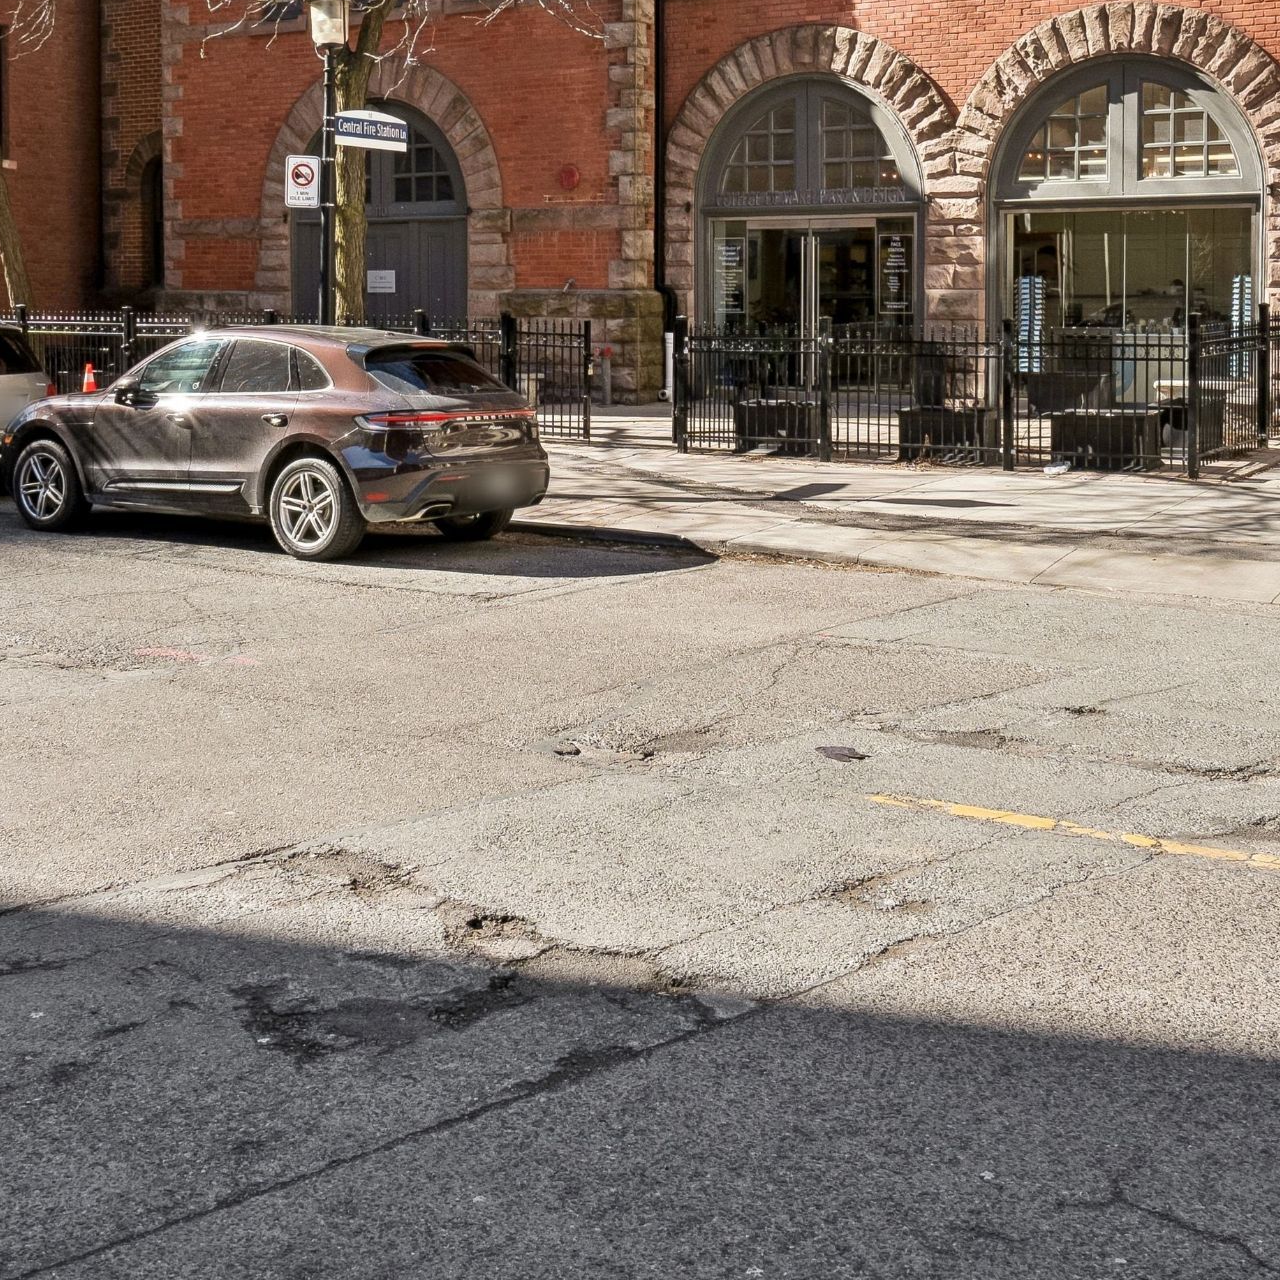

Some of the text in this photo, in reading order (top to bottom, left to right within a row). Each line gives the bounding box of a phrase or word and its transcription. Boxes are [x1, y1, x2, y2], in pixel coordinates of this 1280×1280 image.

[338, 118, 407, 139] Central Fire Station Ln
[864, 186, 906, 202] DESIGN
